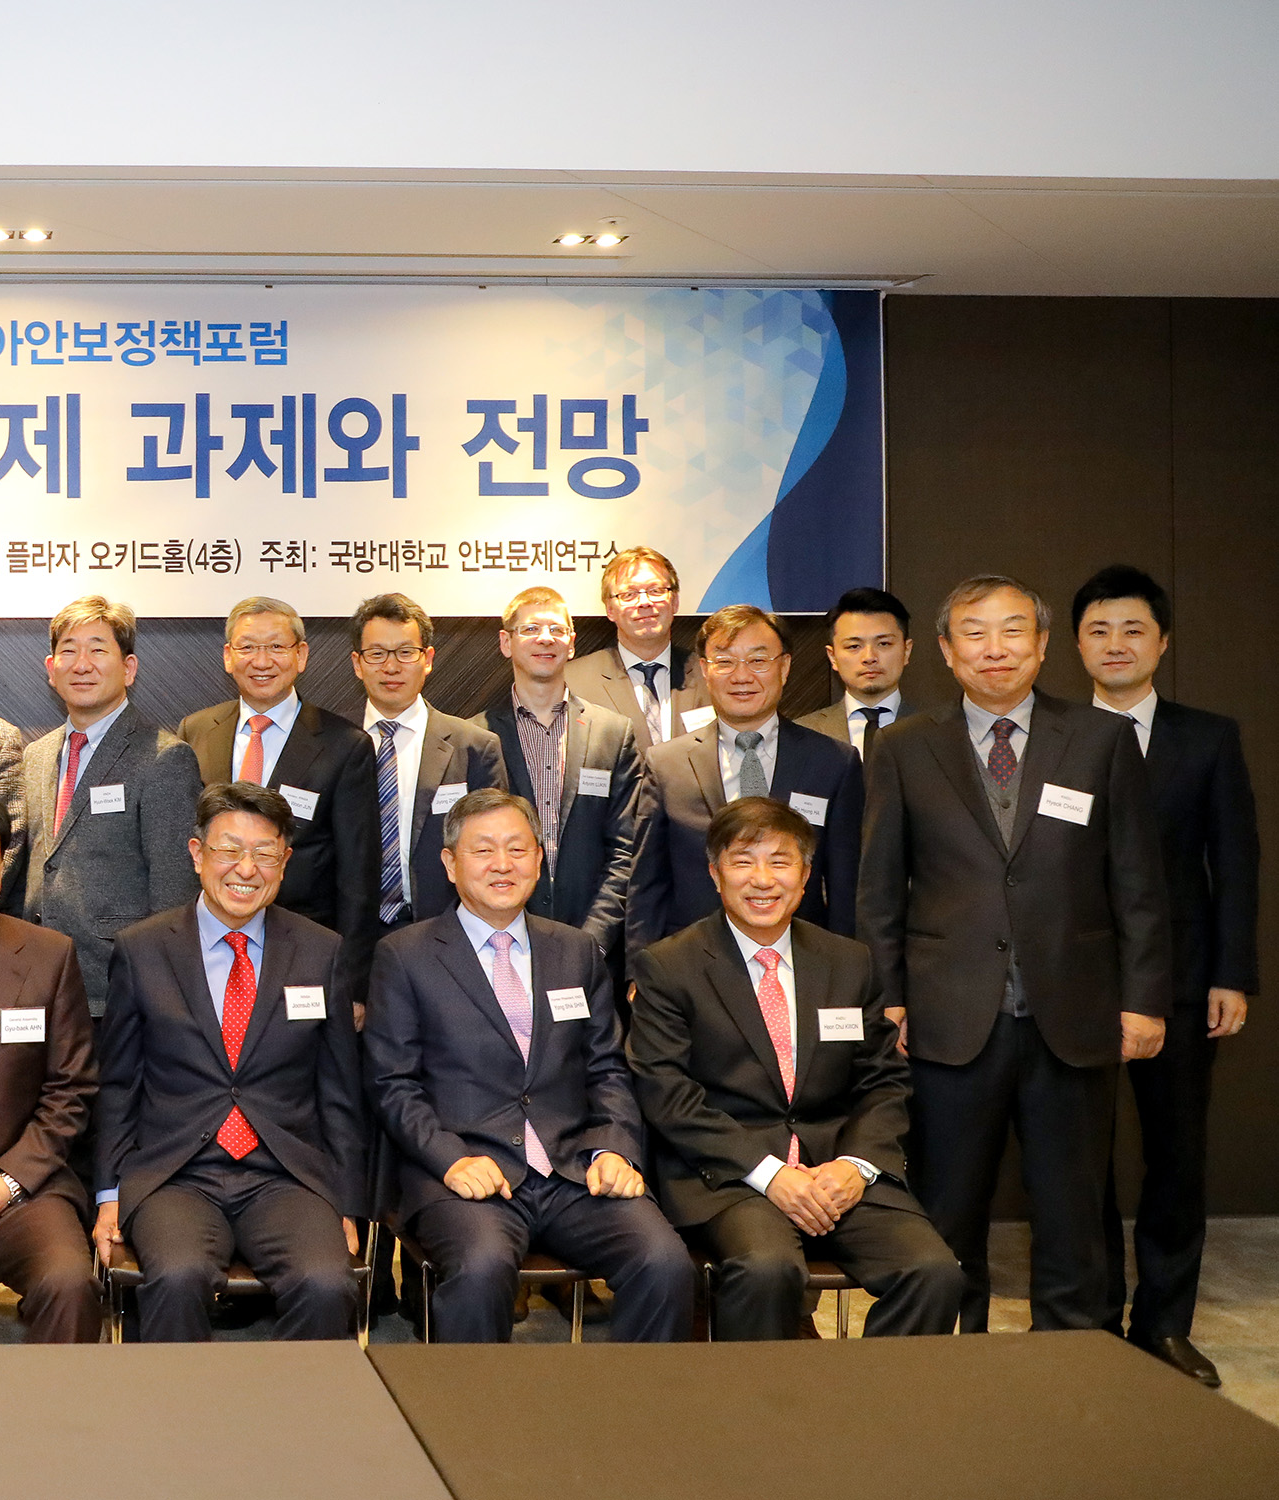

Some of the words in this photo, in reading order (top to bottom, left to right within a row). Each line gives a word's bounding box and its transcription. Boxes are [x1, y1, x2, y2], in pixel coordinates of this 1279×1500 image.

[126, 393, 420, 499] 과제와
[461, 394, 649, 500] 전망
[6, 540, 80, 574] 플라자
[88, 538, 242, 575] 오키드홀(4층)
[259, 539, 317, 573] 주최:
[328, 539, 449, 574] 국방대학교
